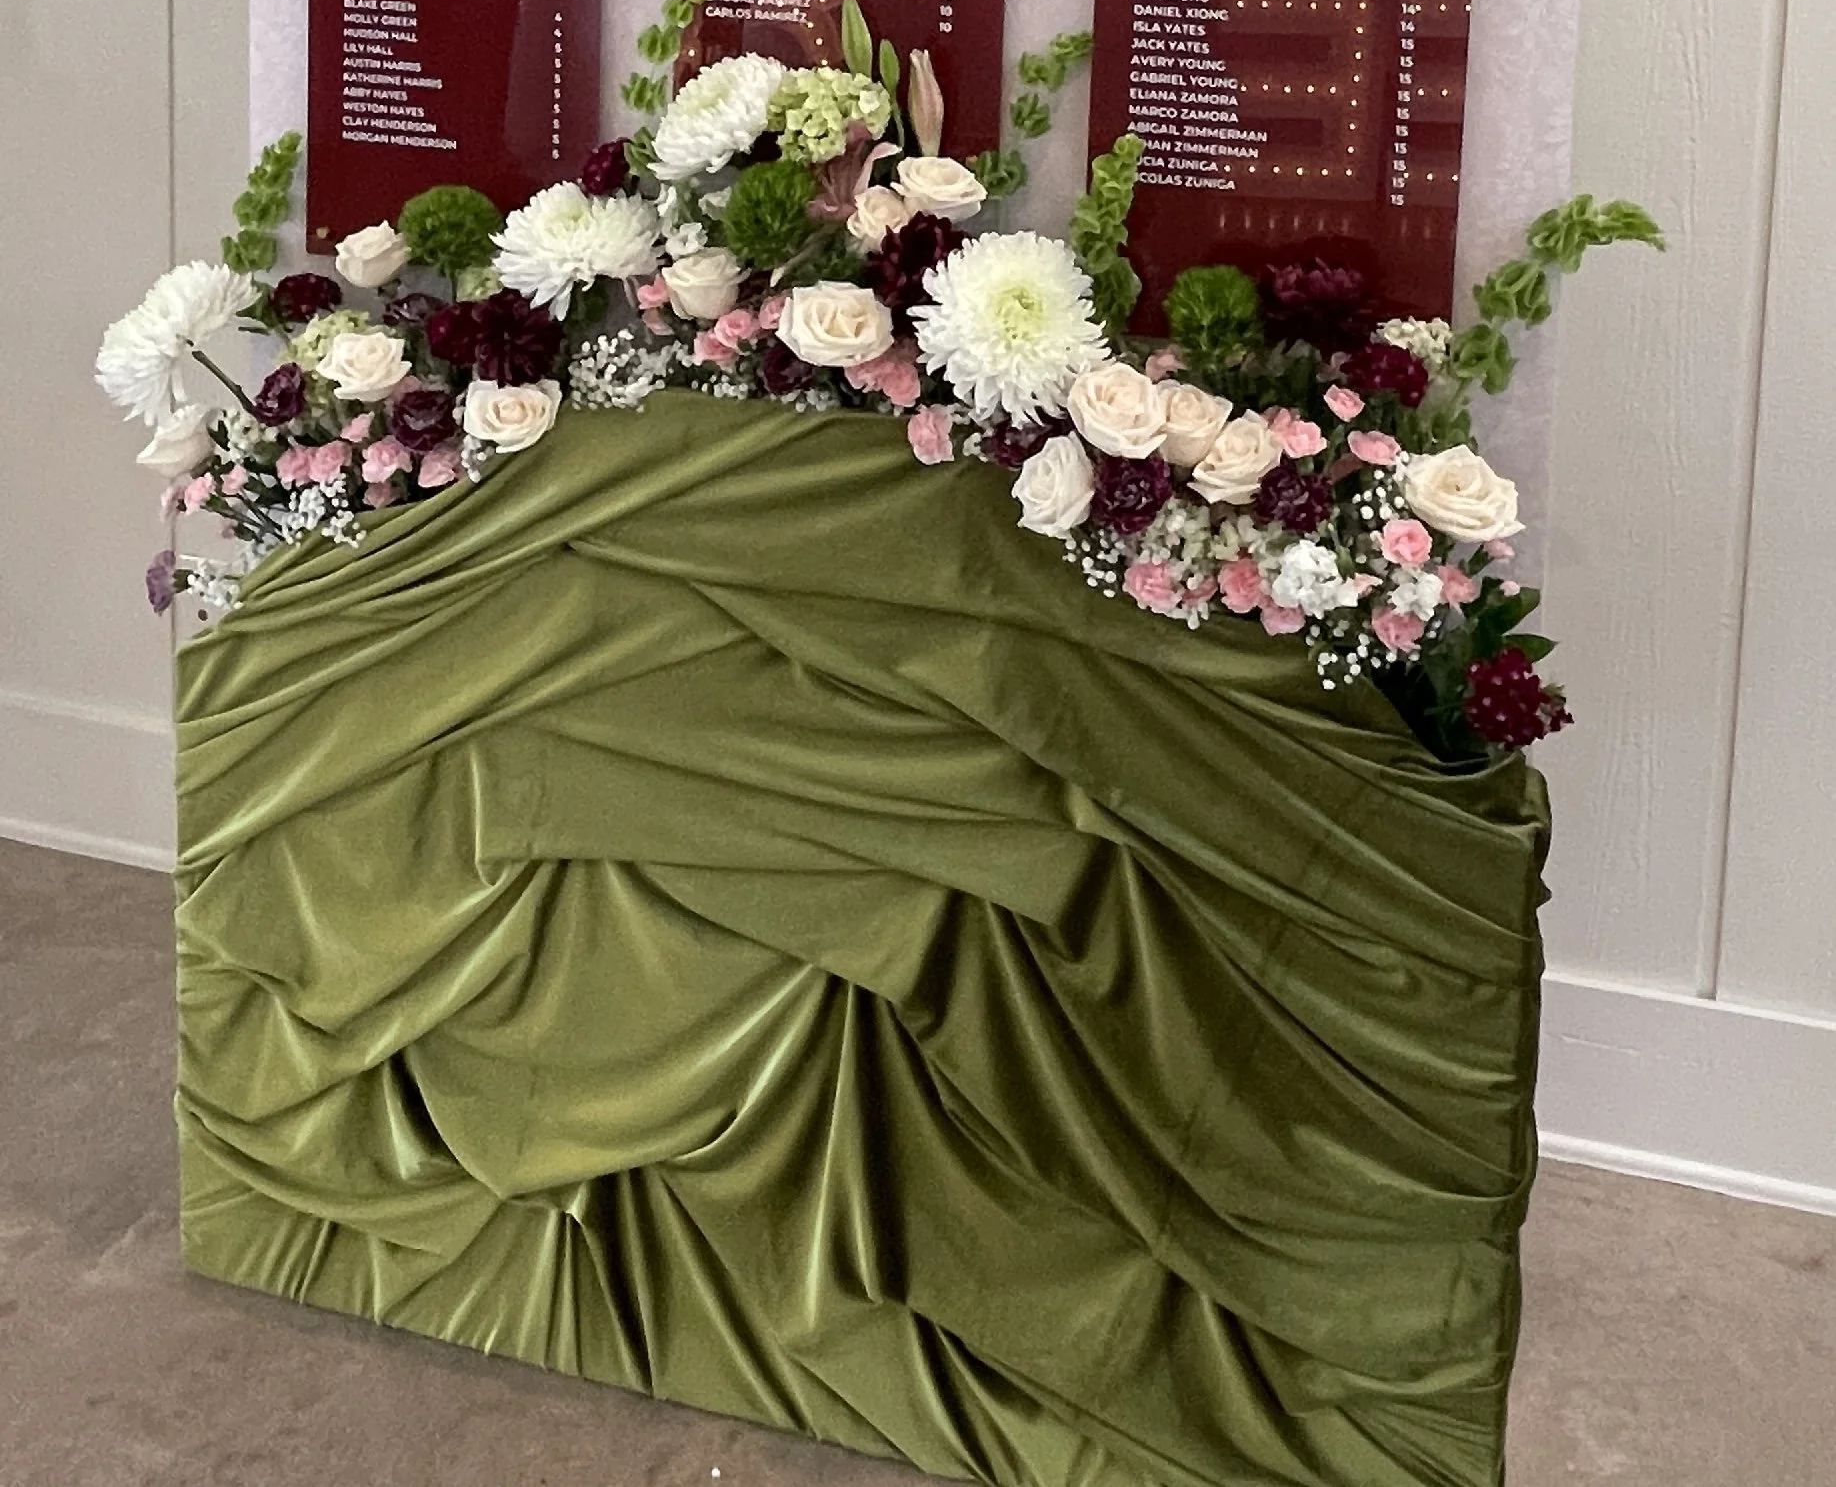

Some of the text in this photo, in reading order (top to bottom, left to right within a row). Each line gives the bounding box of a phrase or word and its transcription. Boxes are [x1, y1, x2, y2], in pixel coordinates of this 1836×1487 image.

[1134, 4, 1182, 18] DANIEL
[1186, 8, 1229, 21] XIONG
[1133, 21, 1161, 33] ISLA
[1164, 23, 1206, 36] YATES
[1131, 38, 1165, 51] JACK
[1168, 41, 1210, 54] YATES
[1129, 88, 1177, 101] ELIANA
[1180, 91, 1238, 106] ZAMORA
[1128, 105, 1178, 119] MARCO
[1180, 109, 1239, 123] ZAMORA
